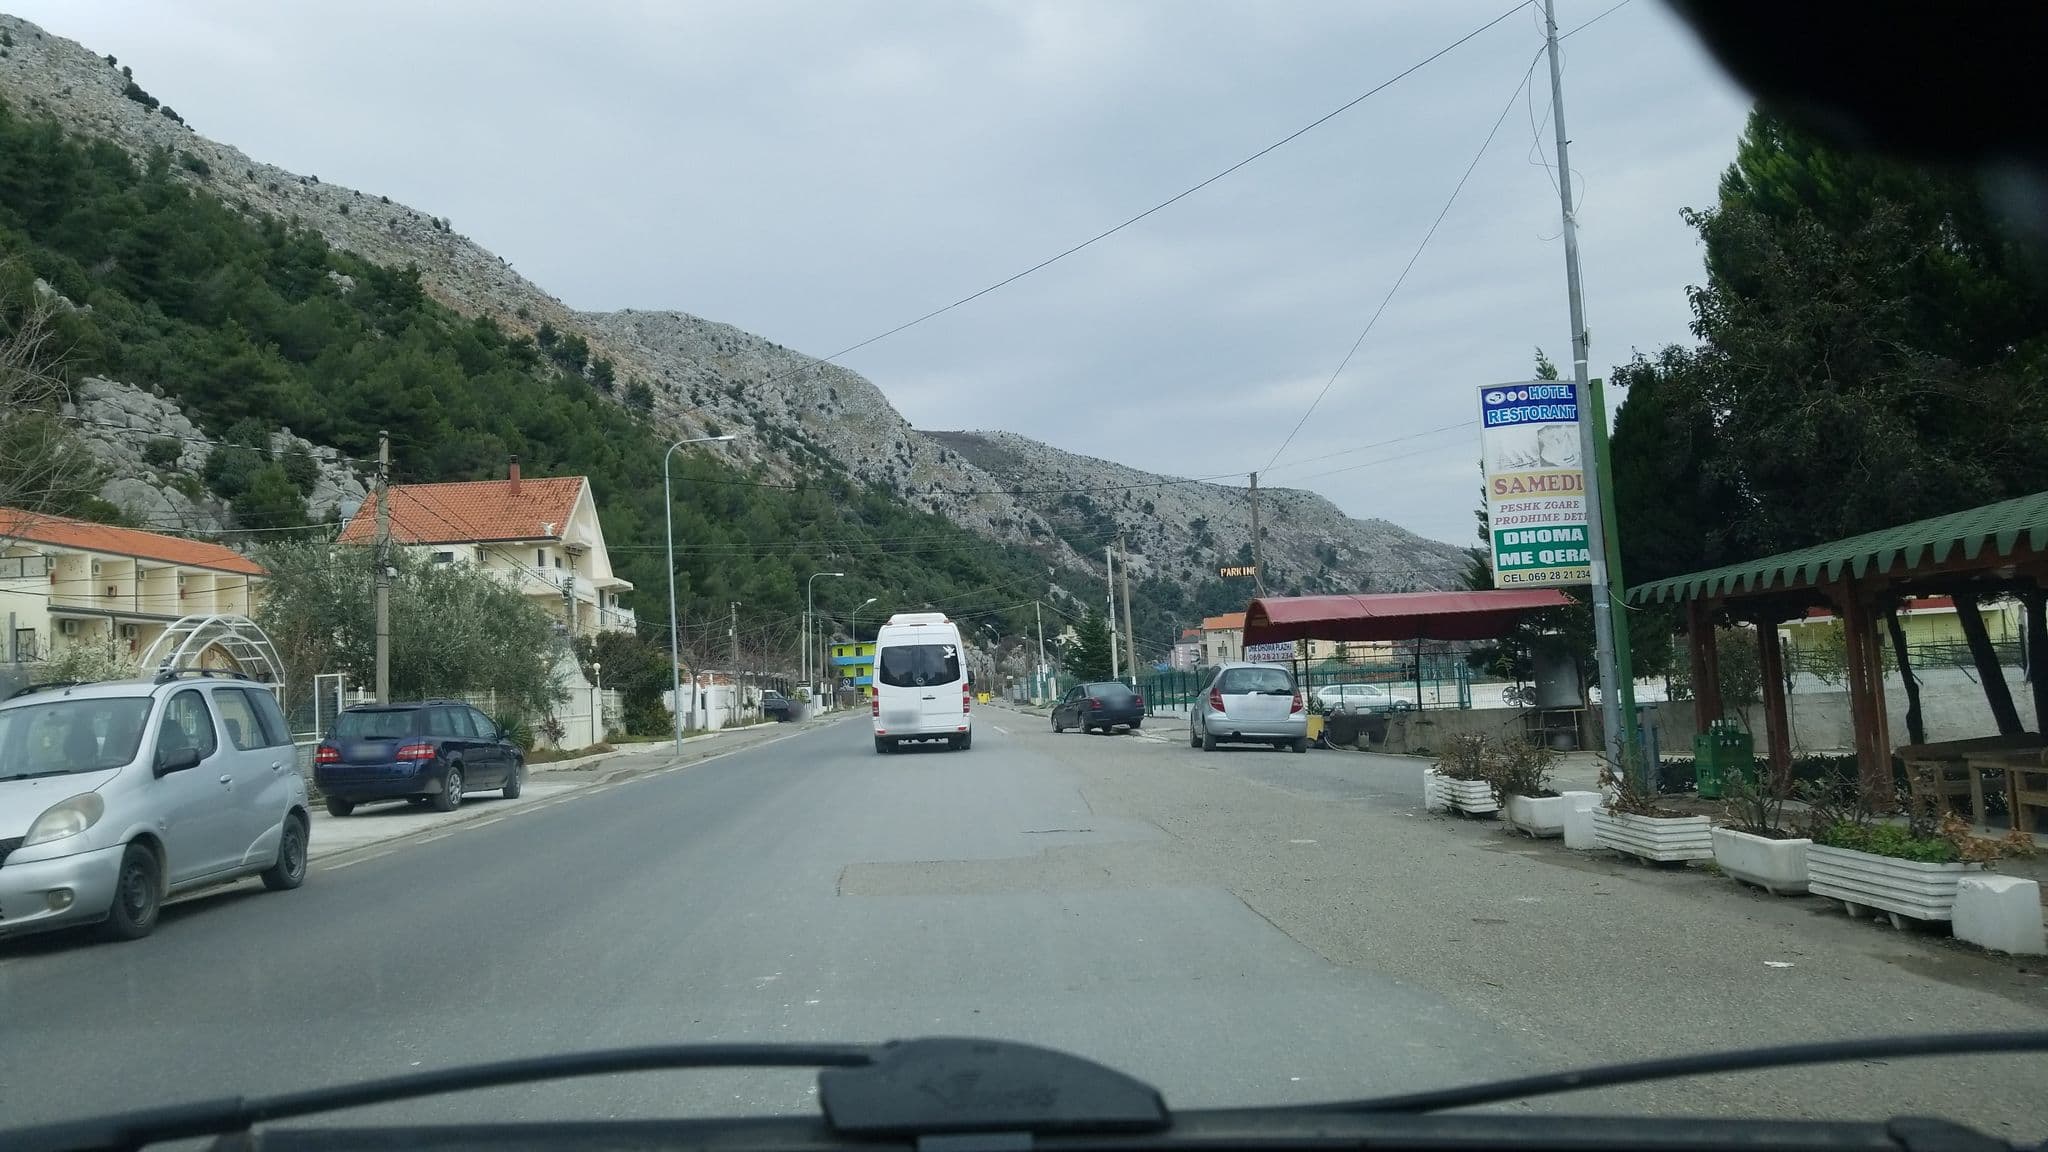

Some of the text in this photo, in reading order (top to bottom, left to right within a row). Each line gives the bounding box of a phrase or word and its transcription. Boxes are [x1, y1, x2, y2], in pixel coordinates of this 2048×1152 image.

[1529, 385, 1573, 400] HOTEL
[1487, 404, 1577, 425] RESTORANT
[1494, 474, 1583, 495] SAMEDI
[1500, 500, 1580, 513] PESHK ZGARE
[1494, 513, 1560, 525] PRODHIME
[1503, 528, 1584, 546] DHOMA
[1499, 548, 1591, 566] ME QERA
[1503, 570, 1591, 583] CEL.069 28 21 234
